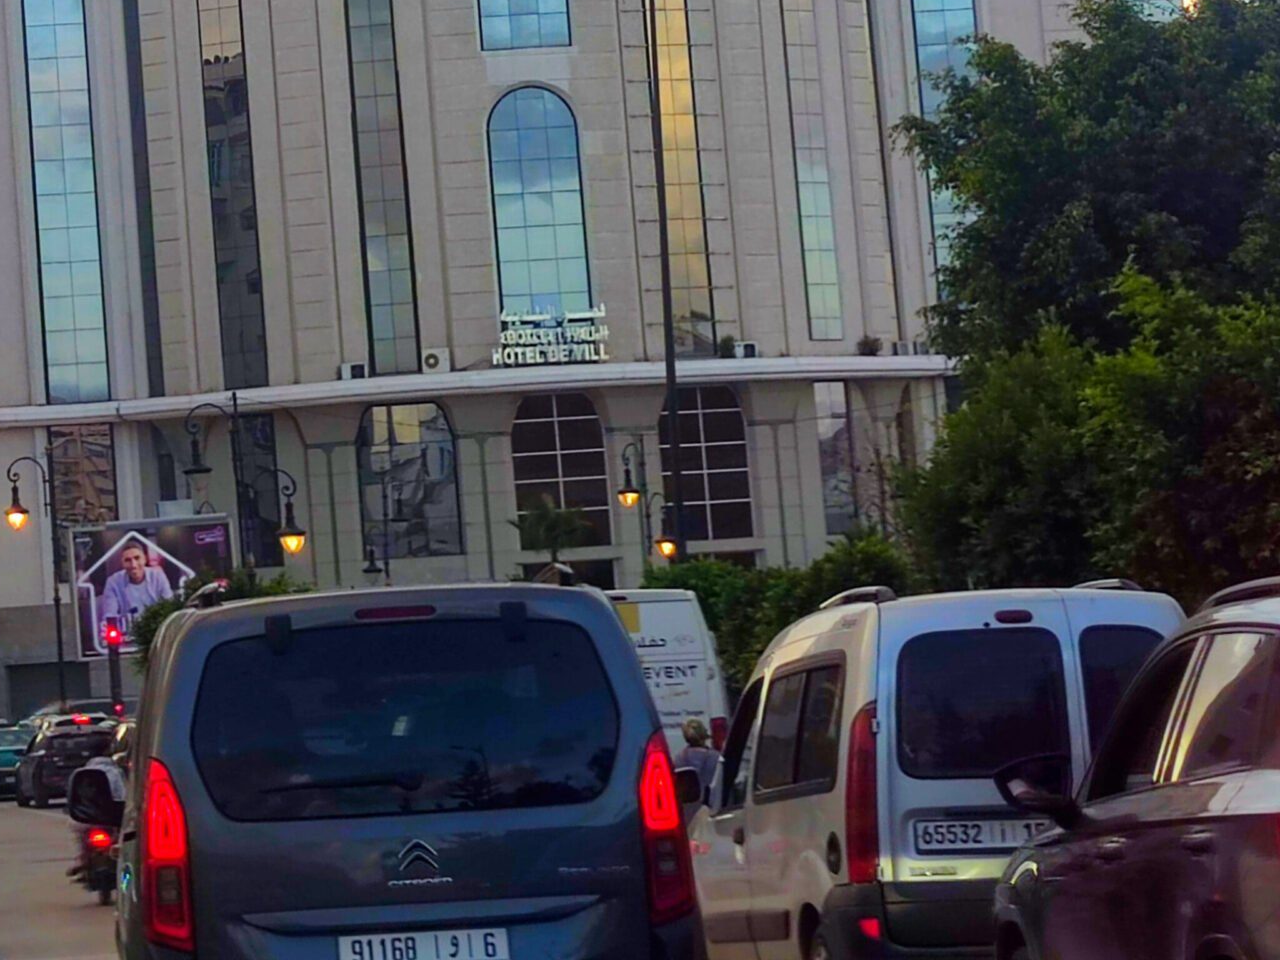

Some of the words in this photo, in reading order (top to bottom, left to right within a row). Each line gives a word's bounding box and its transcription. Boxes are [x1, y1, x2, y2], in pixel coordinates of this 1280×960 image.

[492, 345, 545, 365] HOTEL
[547, 344, 570, 362] DE
[642, 665, 698, 679] EVENT
[922, 823, 983, 844] 65532
[351, 937, 417, 960] 91168
[484, 932, 496, 957] 6
